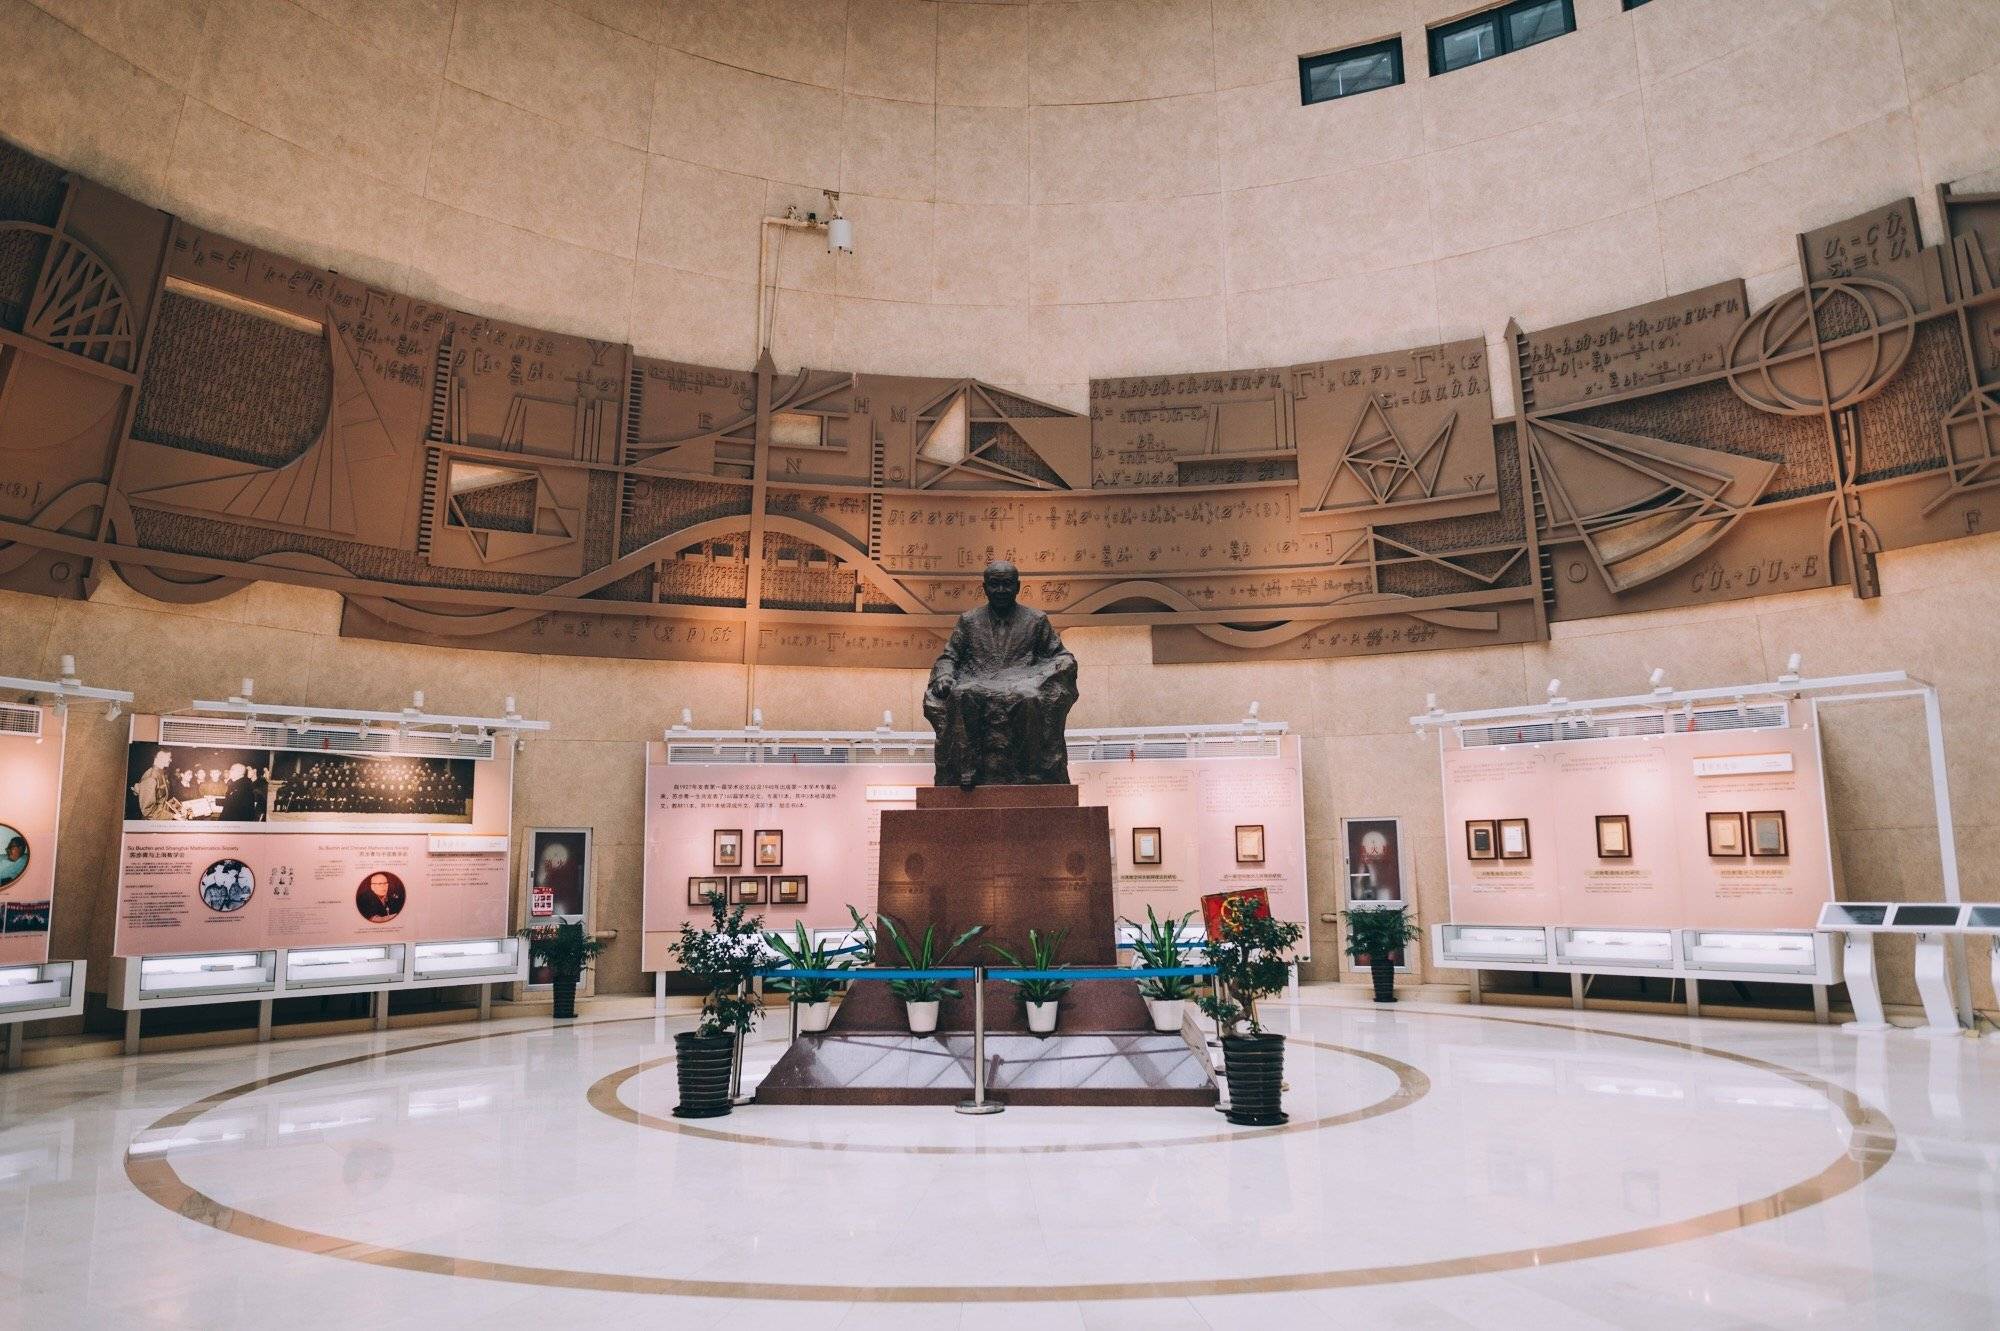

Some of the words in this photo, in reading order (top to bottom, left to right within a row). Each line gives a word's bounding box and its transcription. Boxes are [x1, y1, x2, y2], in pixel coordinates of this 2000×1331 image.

[854, 397, 870, 414] H
[890, 405, 907, 423] M
[785, 455, 803, 475] N
[1567, 561, 1589, 584] O
